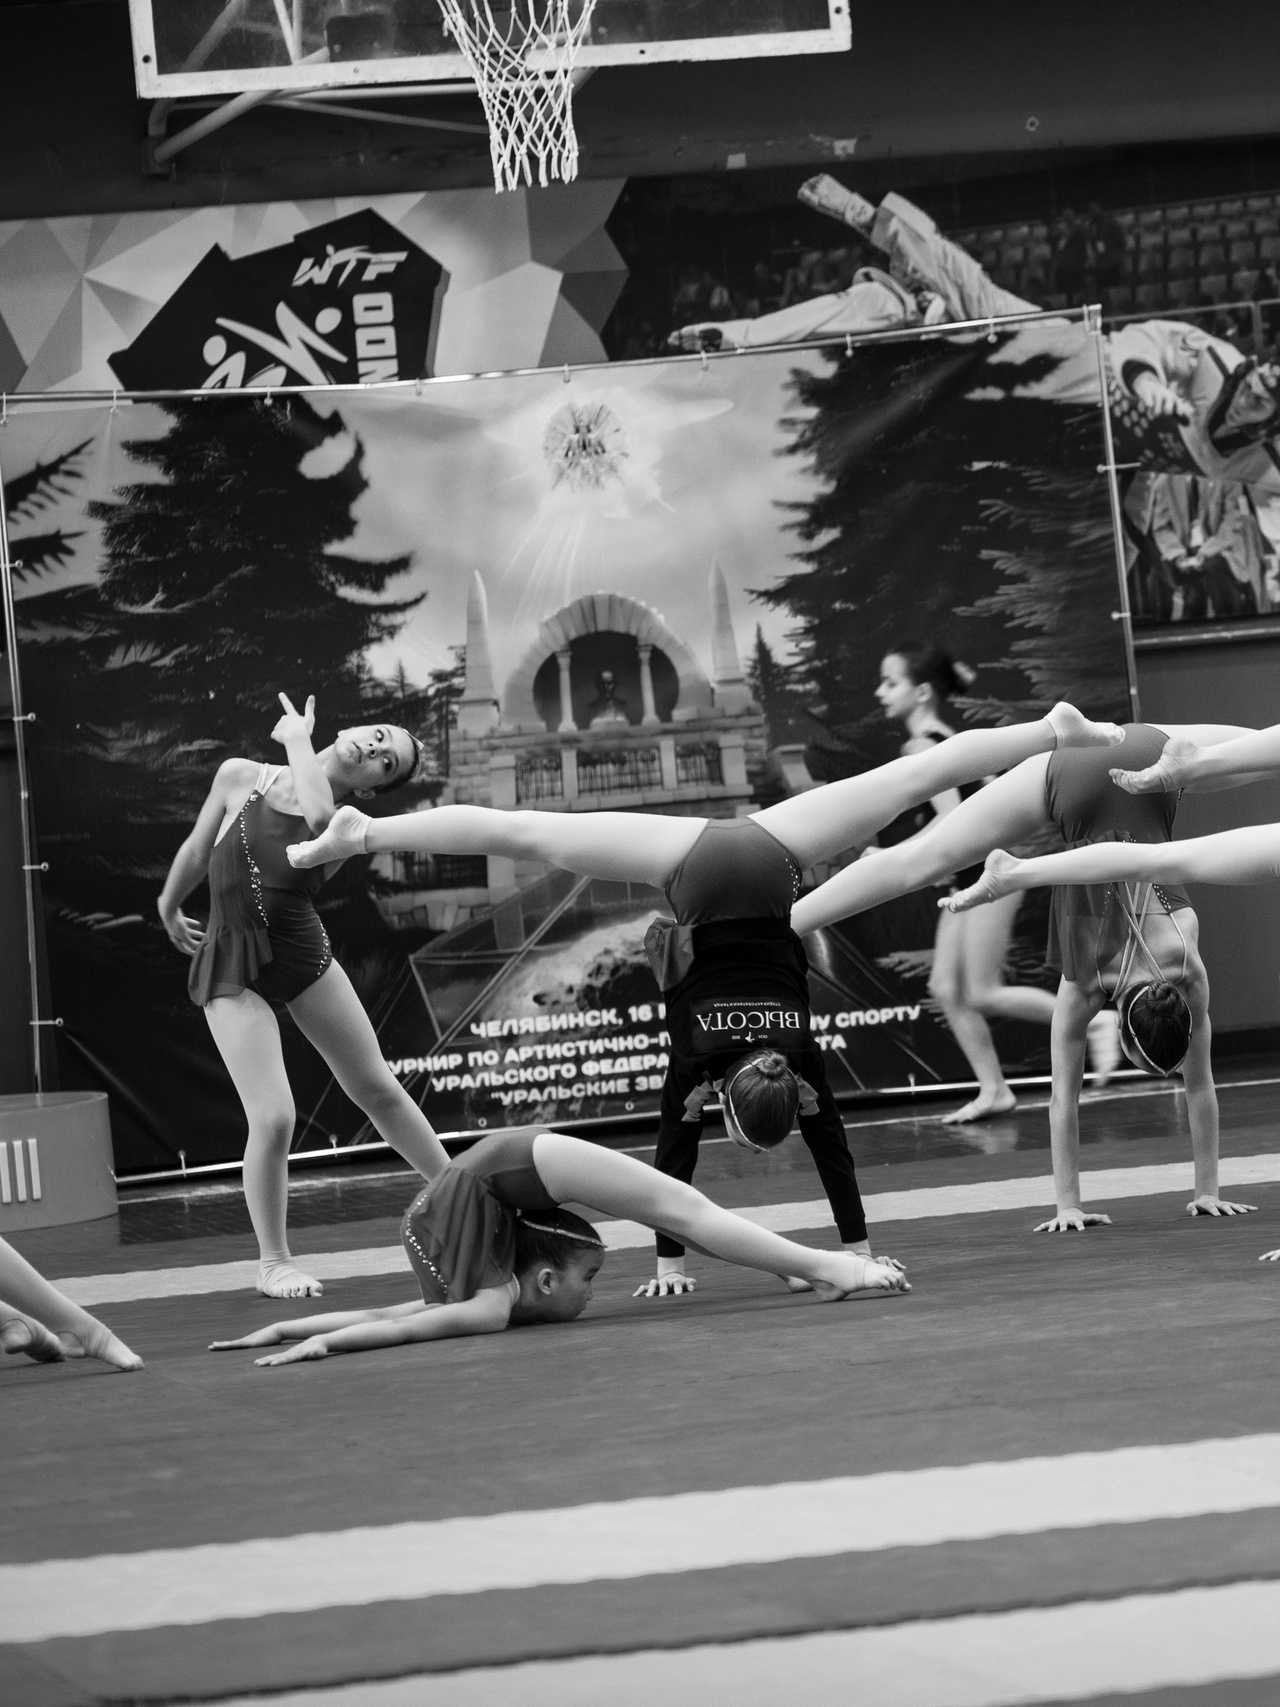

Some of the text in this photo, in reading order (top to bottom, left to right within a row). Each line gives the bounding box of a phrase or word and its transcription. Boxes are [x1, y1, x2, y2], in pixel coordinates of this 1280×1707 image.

[291, 243, 409, 289] WTF
[352, 291, 399, 384] NDO
[383, 1053, 463, 1076] УРНИР
[467, 1050, 499, 1068] ПО
[504, 1031, 672, 1062] АРТИСТИЧНО-П
[834, 1004, 921, 1028] СПОРТУ
[470, 1007, 624, 1039] ЧЕЛЯБИНСК,
[627, 1003, 653, 1022] 16
[696, 1010, 801, 1032] ВЫСОТА
[431, 1062, 577, 1092] УРАЛЬСКОГО
[581, 1053, 670, 1077] ФЕДЕРА
